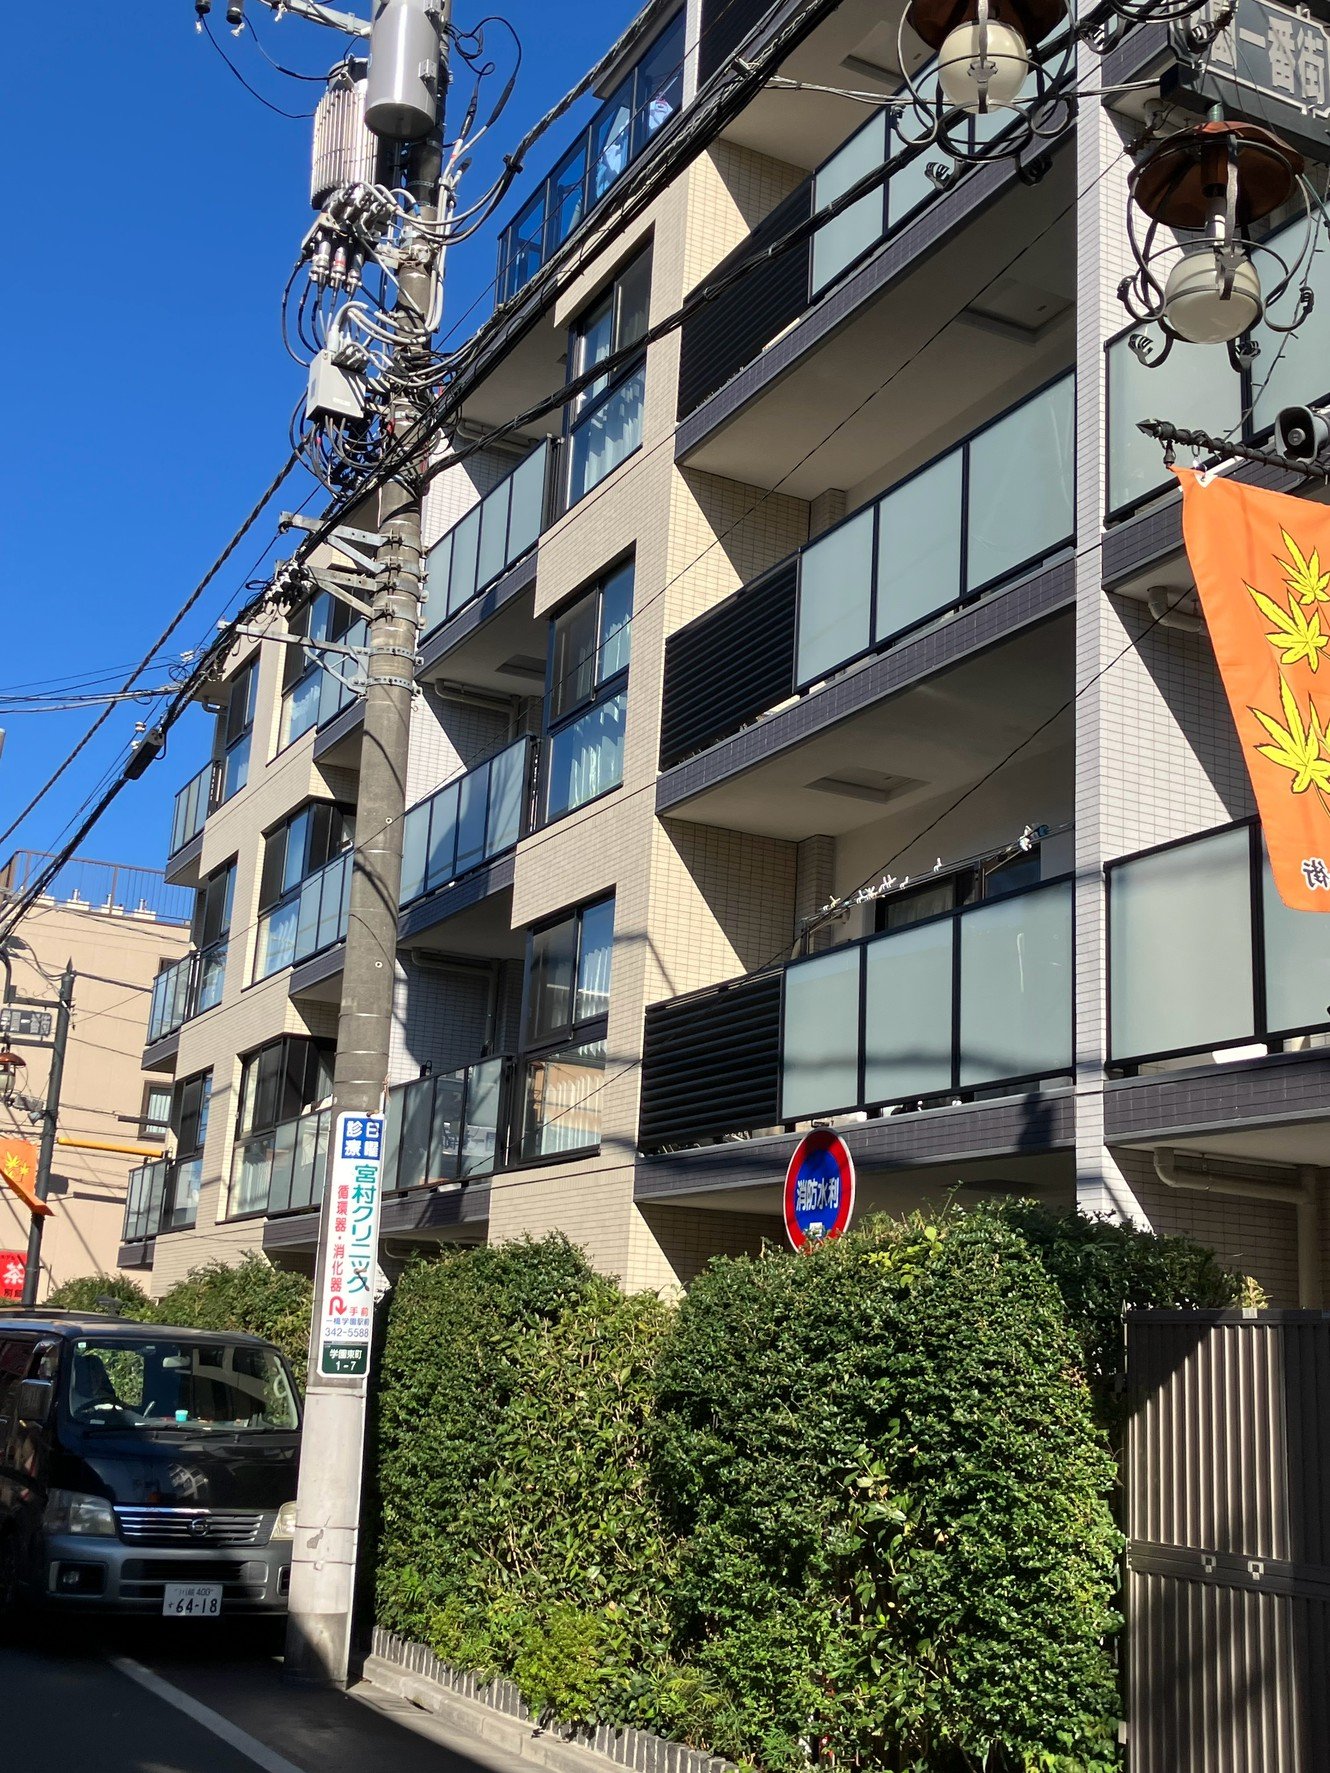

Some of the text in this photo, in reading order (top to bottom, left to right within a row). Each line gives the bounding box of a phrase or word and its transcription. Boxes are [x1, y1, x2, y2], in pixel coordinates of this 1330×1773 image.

[344, 1120, 363, 1157] 診療
[796, 1177, 839, 1211] 消防水利
[330, 1184, 350, 1293] 循環器・消化器
[347, 1163, 378, 1294] 宮村クリニック
[325, 1327, 369, 1338] 342-5588
[329, 1349, 363, 1360] 学園東町
[335, 1361, 356, 1371] 1-7
[176, 1598, 218, 1613] 64-18
